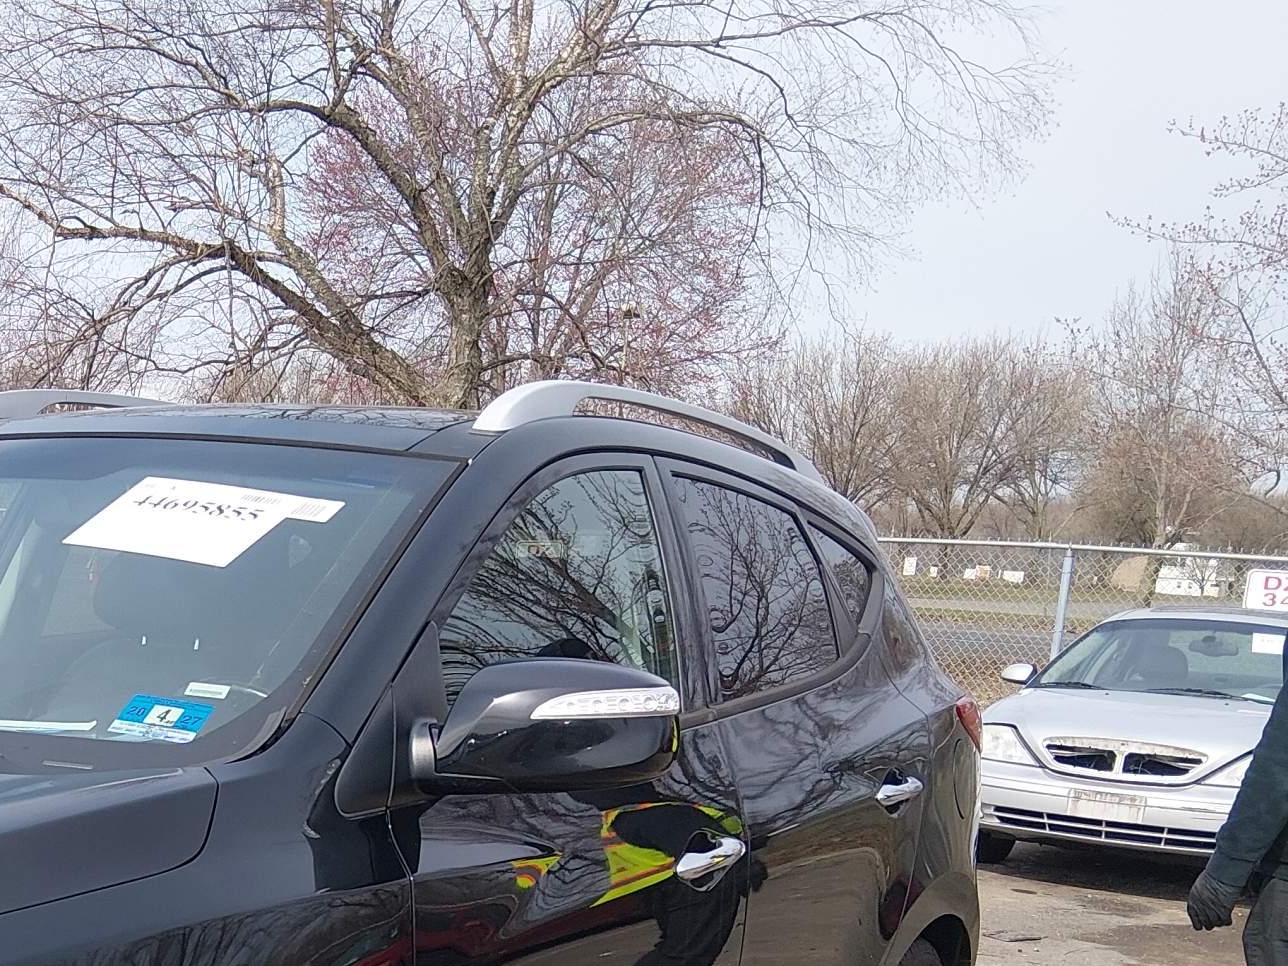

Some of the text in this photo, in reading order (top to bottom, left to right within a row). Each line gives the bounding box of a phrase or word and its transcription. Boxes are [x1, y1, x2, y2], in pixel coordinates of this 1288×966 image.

[133, 495, 265, 521] 44695855
[127, 706, 146, 717] 20
[156, 709, 172, 723] 4
[180, 715, 203, 727] 27
